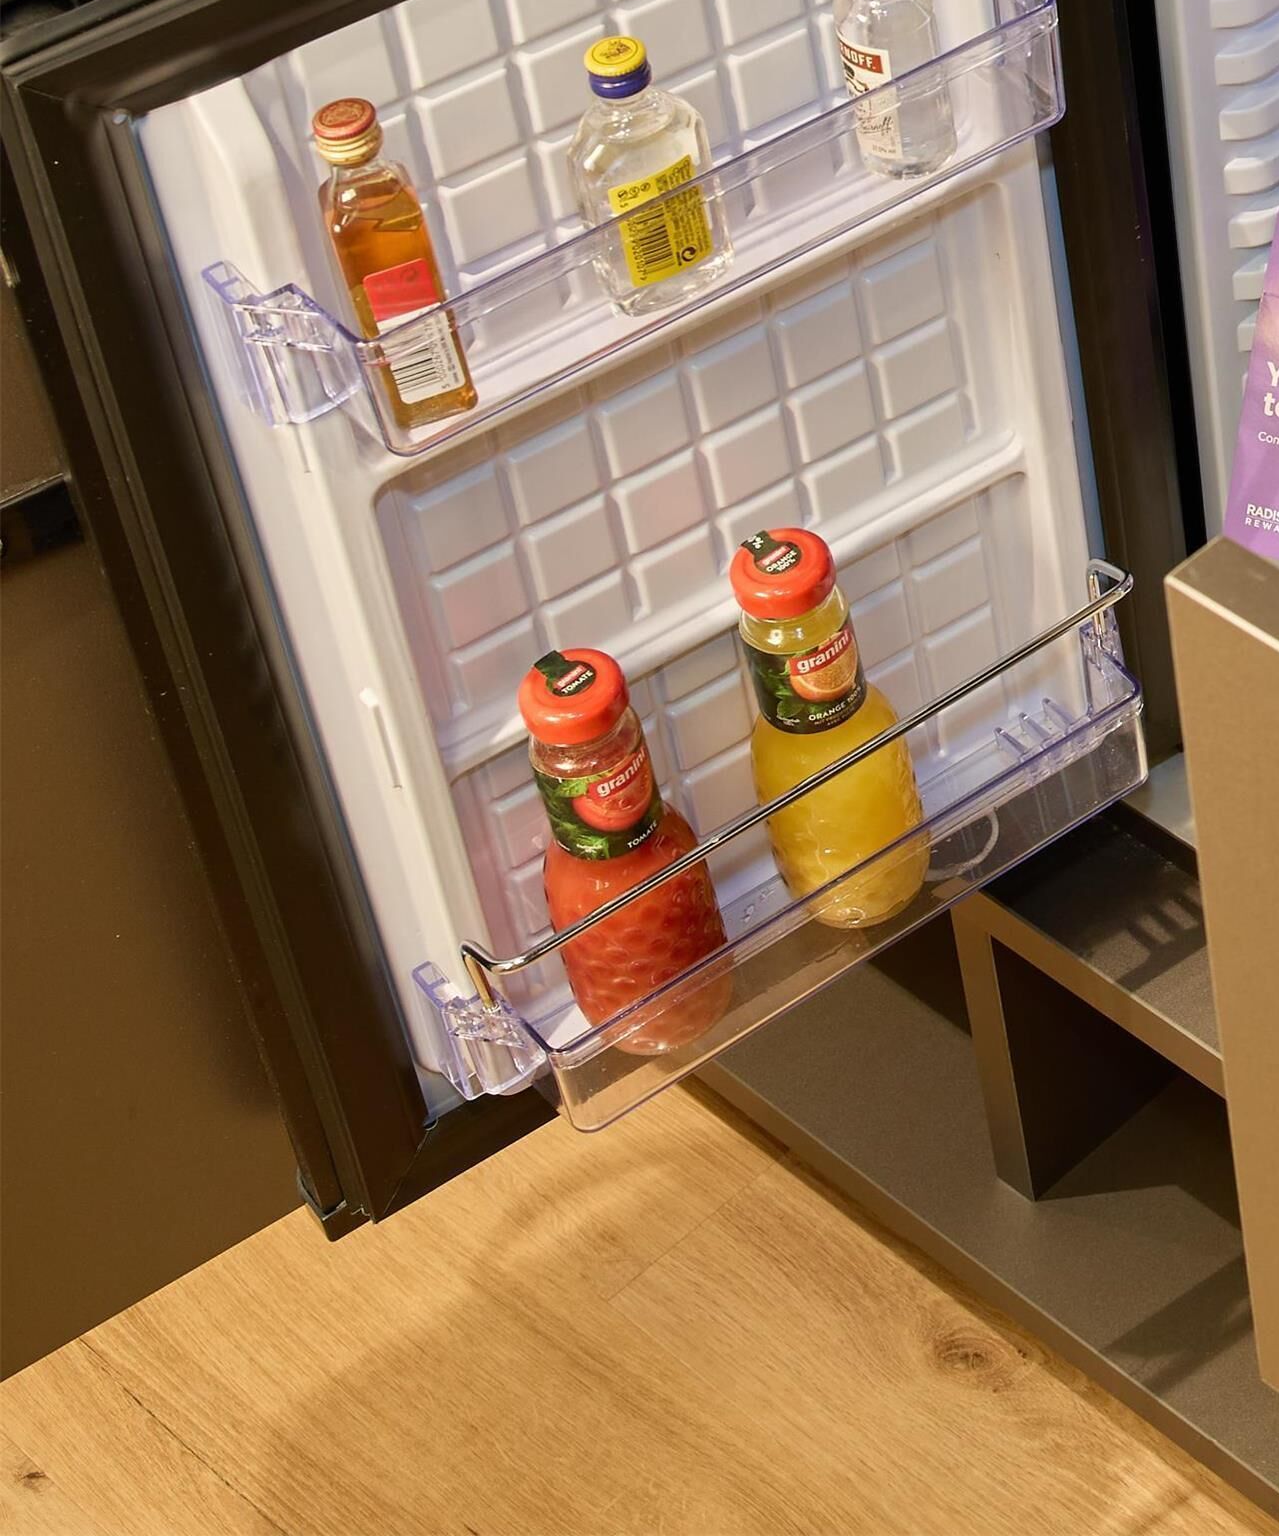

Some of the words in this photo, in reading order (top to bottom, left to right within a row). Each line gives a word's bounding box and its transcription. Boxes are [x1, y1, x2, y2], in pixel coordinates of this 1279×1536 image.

[766, 550, 798, 572] ORANGE
[797, 631, 850, 674] granini
[561, 670, 594, 694] TOMATE
[808, 700, 846, 722] ORANGE
[597, 748, 646, 798] granini
[627, 820, 658, 850] TOMATE
